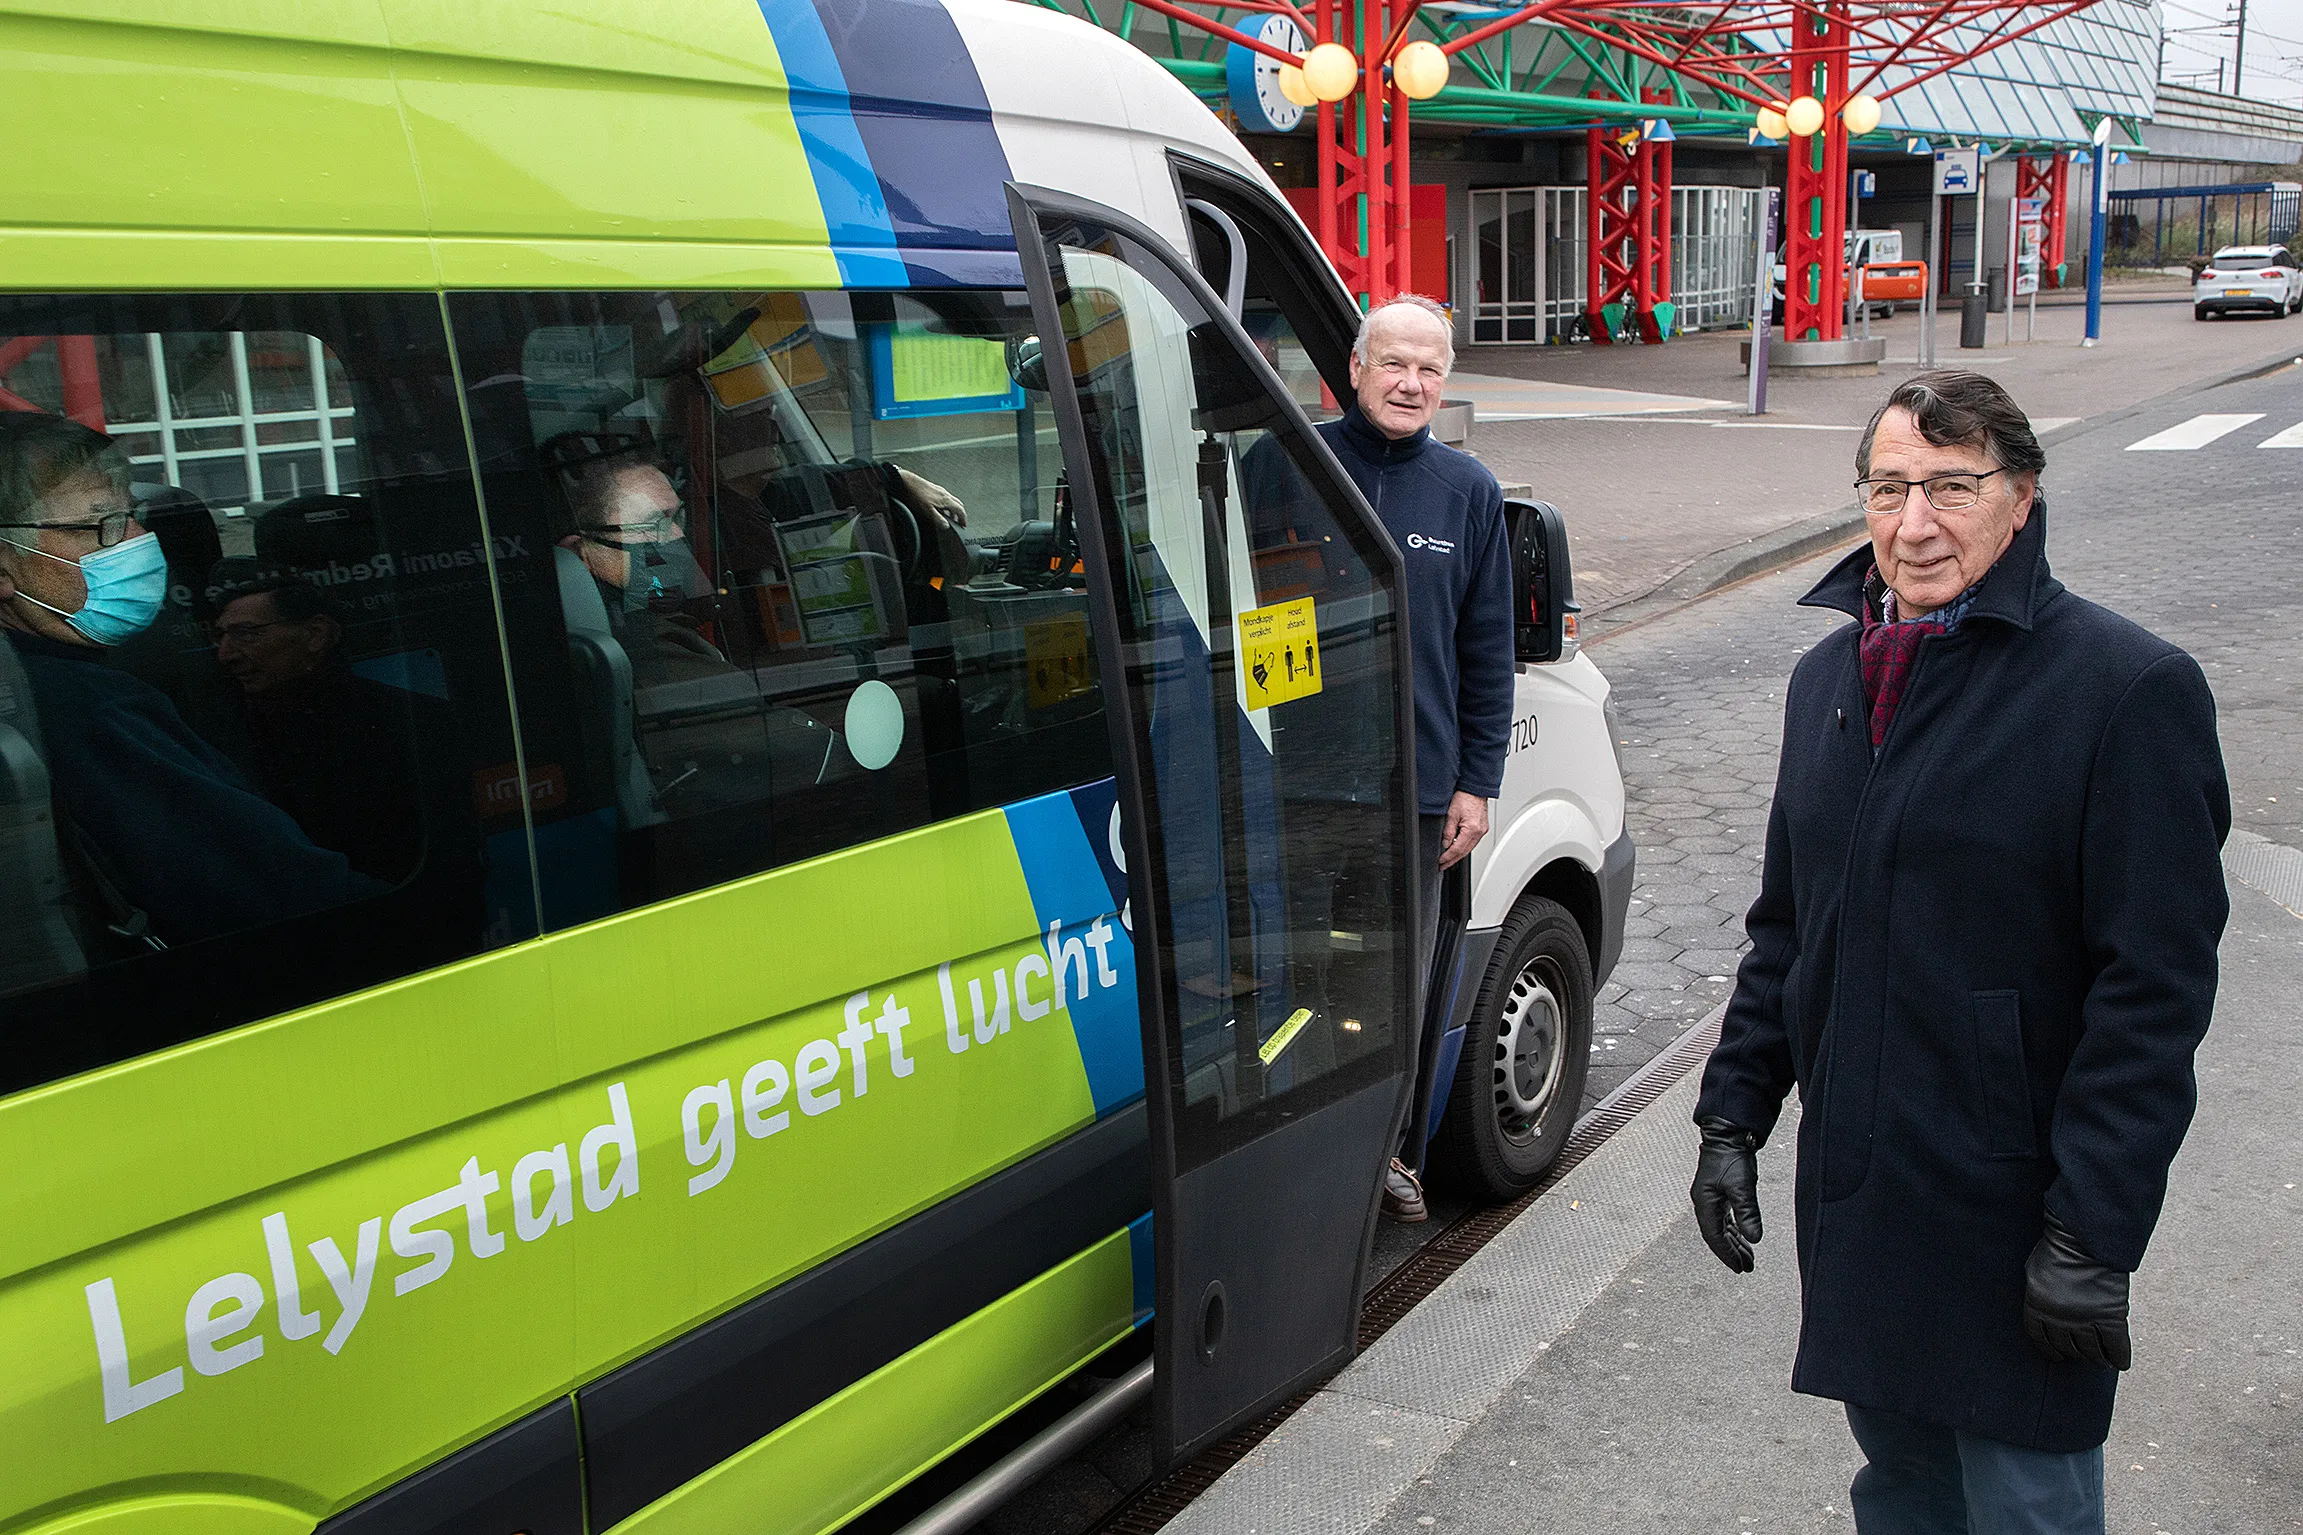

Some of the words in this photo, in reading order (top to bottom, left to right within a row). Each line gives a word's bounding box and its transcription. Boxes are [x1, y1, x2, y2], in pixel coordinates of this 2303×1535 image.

[85, 1081, 640, 1425] Lelystad
[681, 990, 915, 1197] geeft
[937, 914, 1118, 1054] lucht
